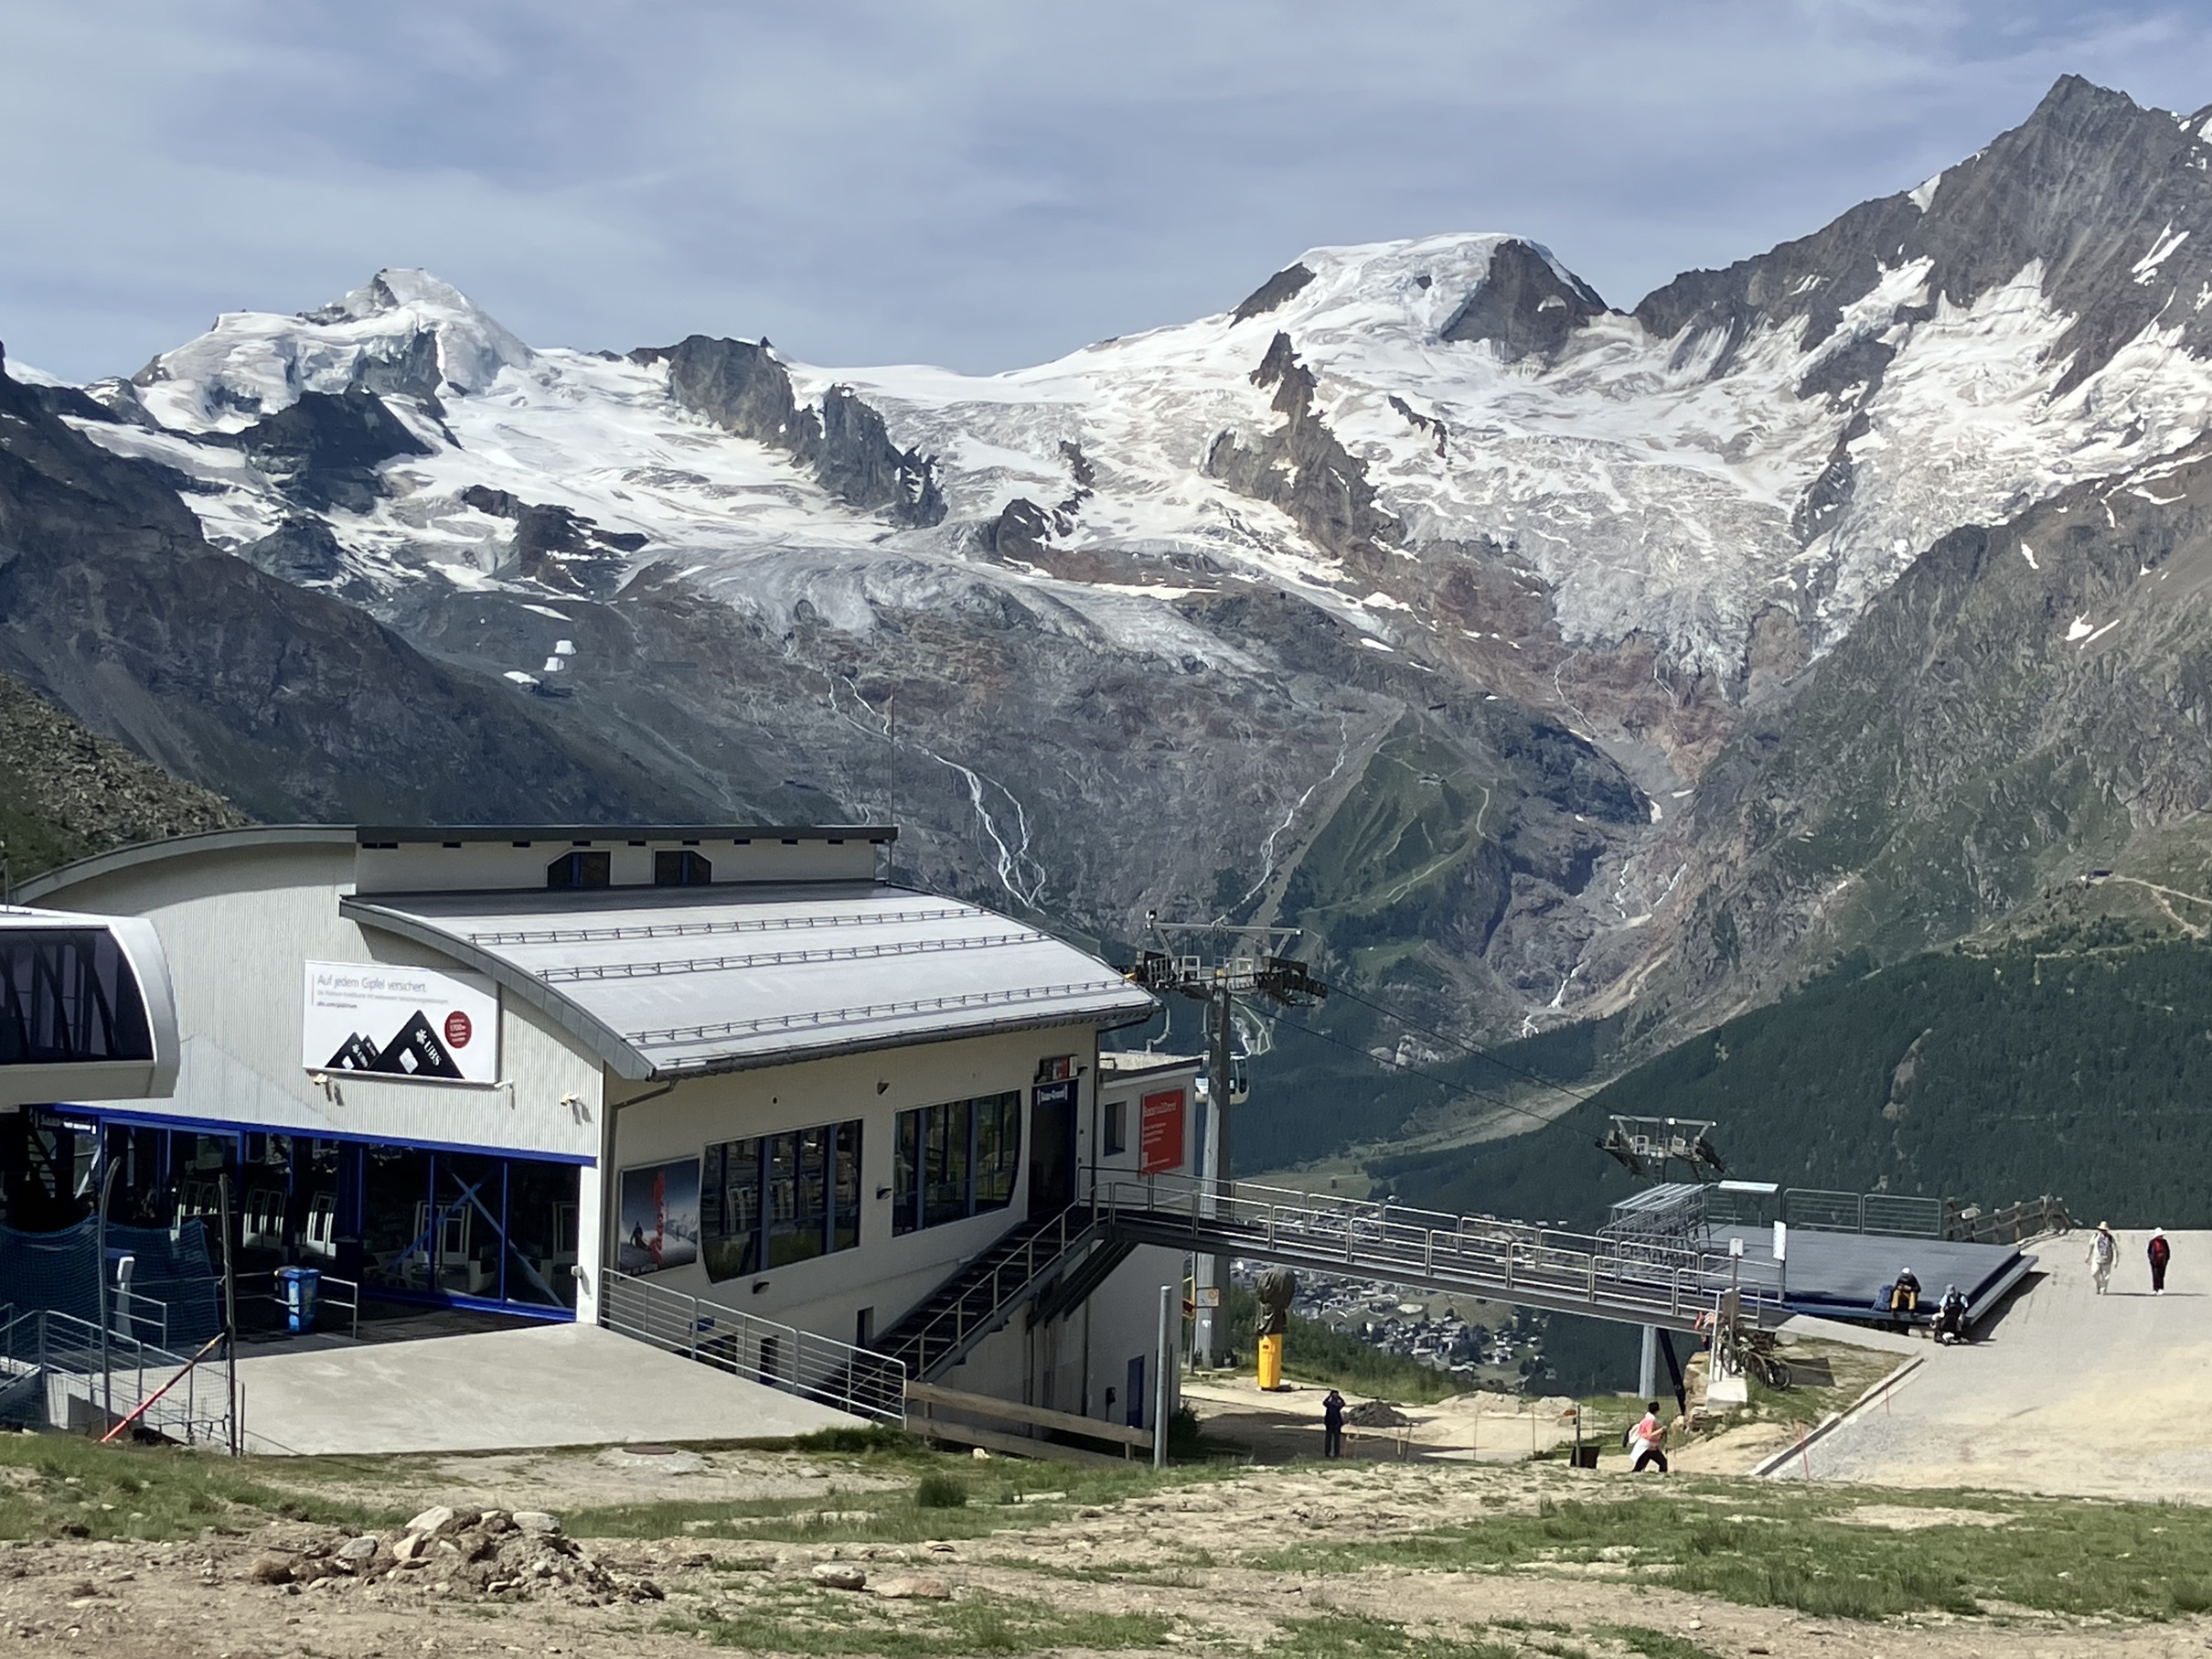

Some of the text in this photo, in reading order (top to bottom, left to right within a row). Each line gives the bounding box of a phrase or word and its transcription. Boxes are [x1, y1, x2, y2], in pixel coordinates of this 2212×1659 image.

[317, 974, 332, 985] Auf
[334, 976, 359, 989] jedem
[361, 977, 385, 991] Gipfel
[423, 1040, 442, 1066] UBS
